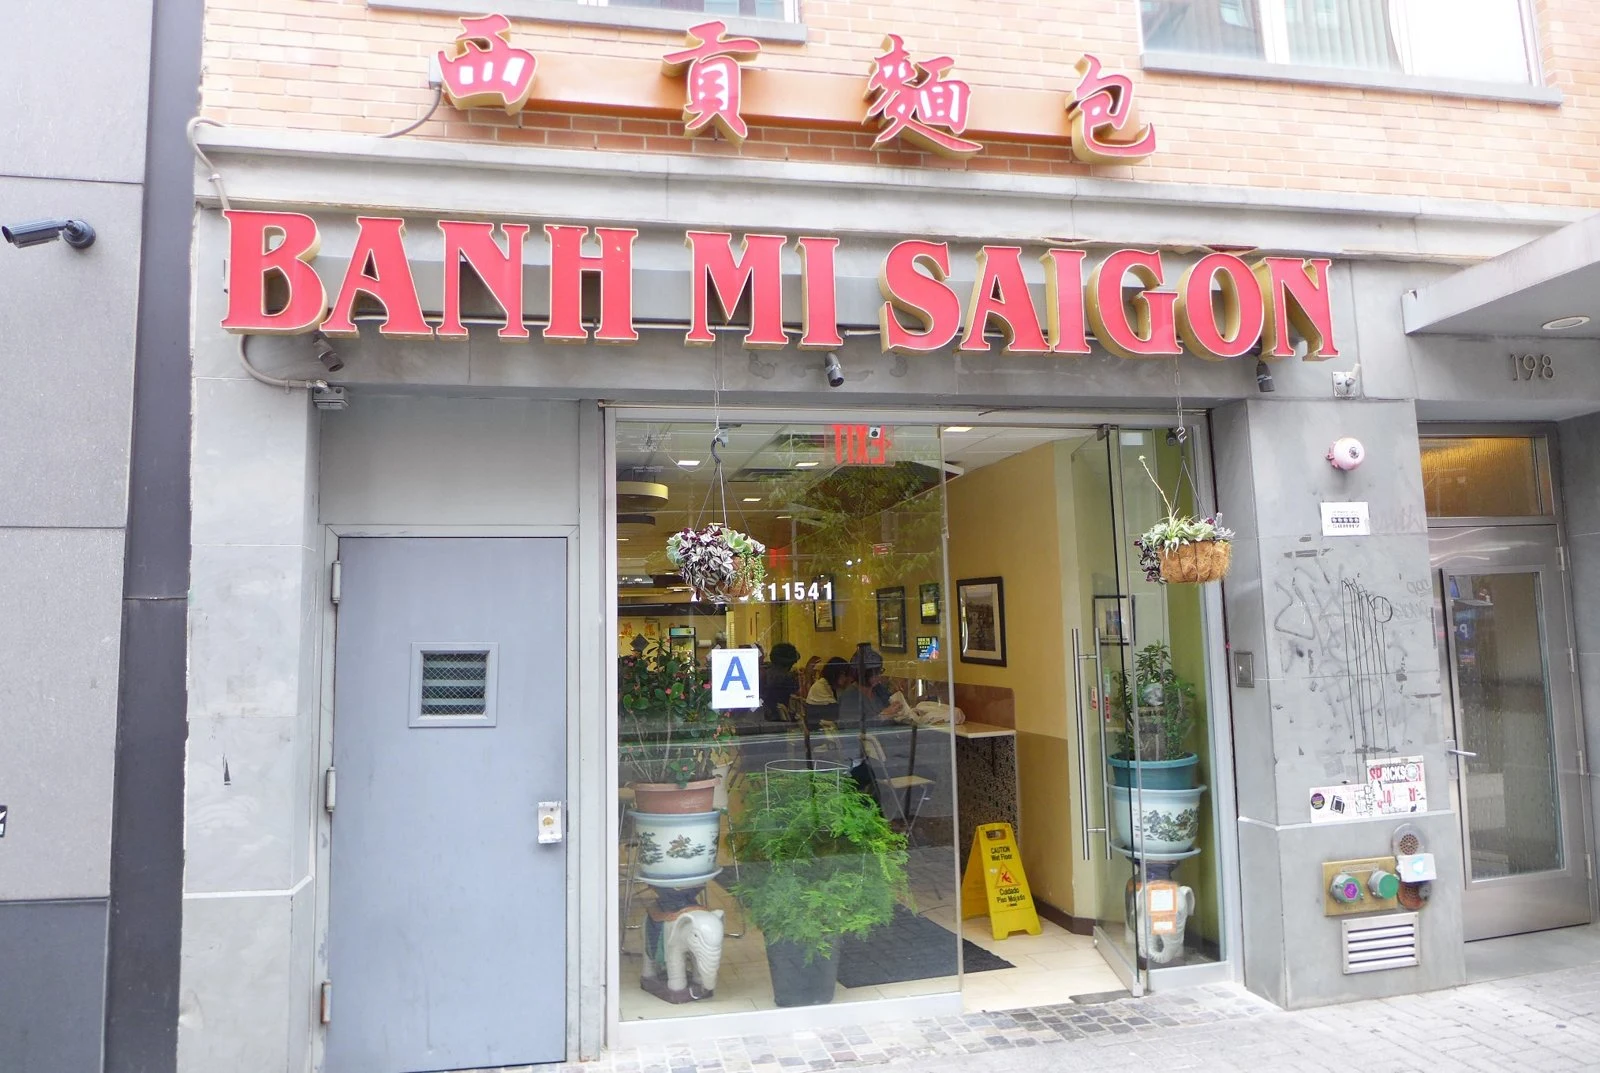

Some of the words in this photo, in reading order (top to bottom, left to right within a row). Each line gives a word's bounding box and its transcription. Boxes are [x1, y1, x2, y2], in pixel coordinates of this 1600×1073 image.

[437, 14, 1157, 160] 西貢麵包
[220, 209, 640, 341] BANH
[684, 230, 845, 347] MI
[881, 239, 1339, 358] SAIGON
[1510, 353, 1555, 381] 198
[720, 656, 751, 691] A
[990, 846, 1010, 854] CAUTION
